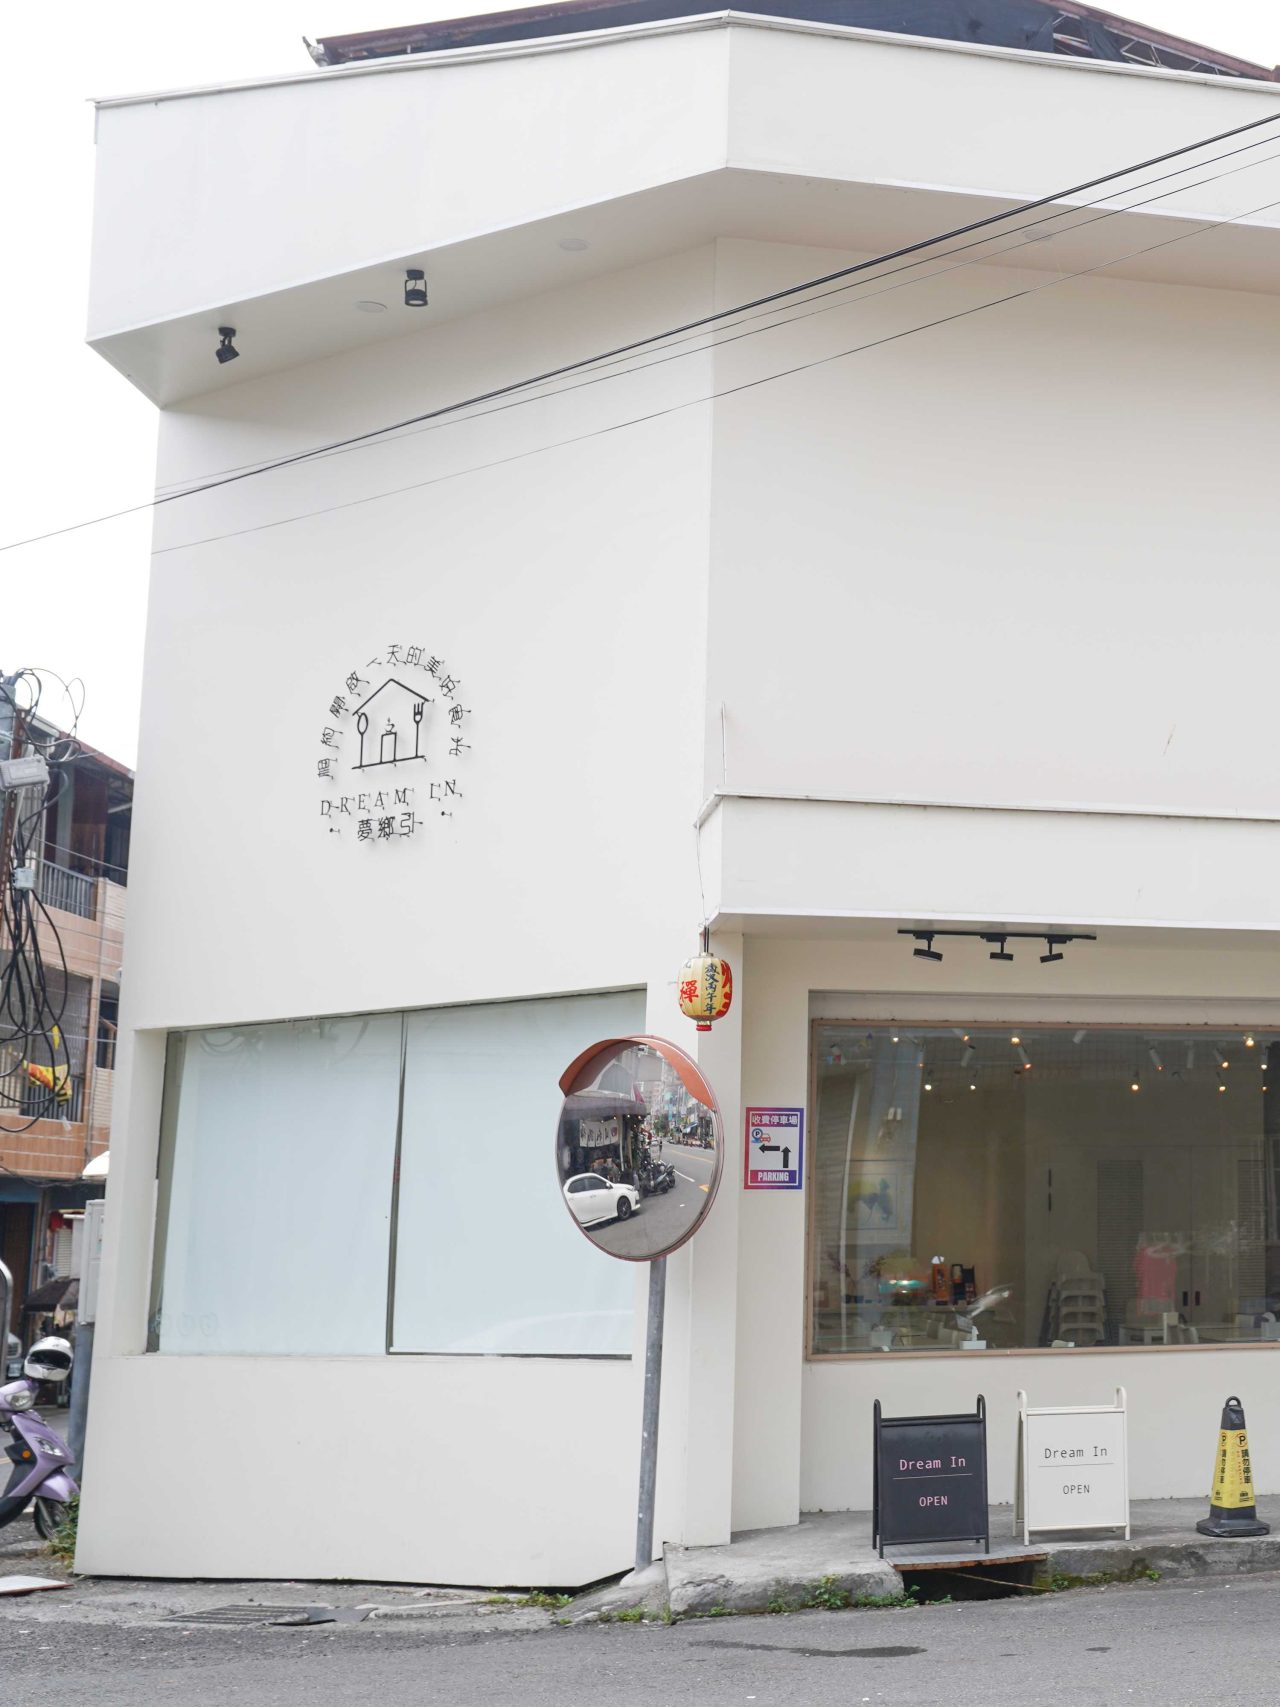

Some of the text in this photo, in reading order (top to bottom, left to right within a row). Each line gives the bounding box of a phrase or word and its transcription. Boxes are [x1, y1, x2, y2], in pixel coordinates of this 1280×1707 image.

[320, 779, 461, 816] DREAM IN
[357, 812, 416, 842] 夢鄉引
[752, 1115, 798, 1125] 收費停車場
[757, 1172, 789, 1182] PARKING
[1044, 1446, 1108, 1459] Dream In
[900, 1456, 966, 1471] Dream In
[1062, 1484, 1090, 1495] OPEN
[919, 1496, 948, 1507] OPEN
